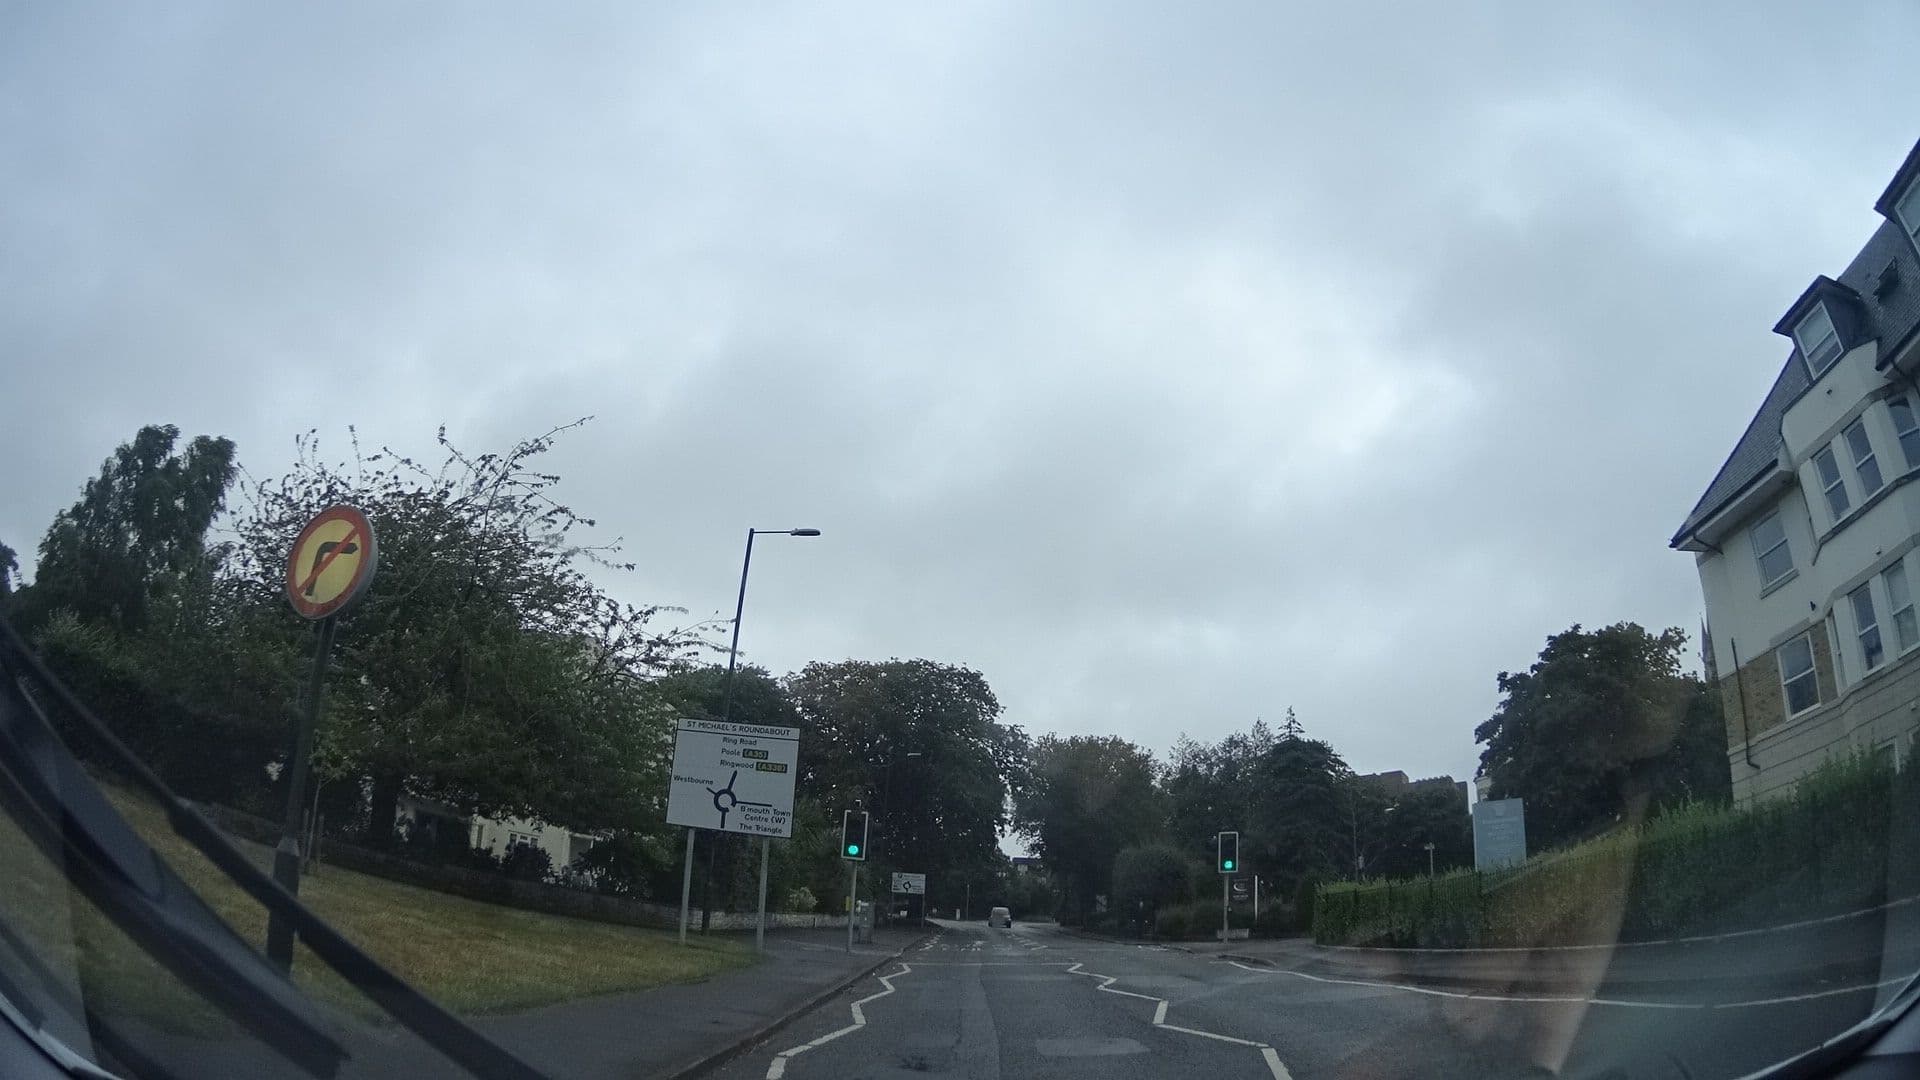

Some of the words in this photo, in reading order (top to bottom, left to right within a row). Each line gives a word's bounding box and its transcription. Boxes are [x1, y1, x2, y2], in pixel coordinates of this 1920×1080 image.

[698, 722, 737, 732] MICHAEL'S
[739, 726, 790, 736] ROUNDABOUT
[721, 748, 740, 756] Poole
[744, 750, 768, 759] (A35)
[720, 760, 754, 769] Ringwood
[674, 775, 714, 785] Westbourne
[740, 806, 770, 815] Bmouth
[773, 808, 790, 816] Town
[744, 814, 768, 822] Centre
[771, 816, 786, 824] (W)
[756, 824, 782, 834] Triangle
